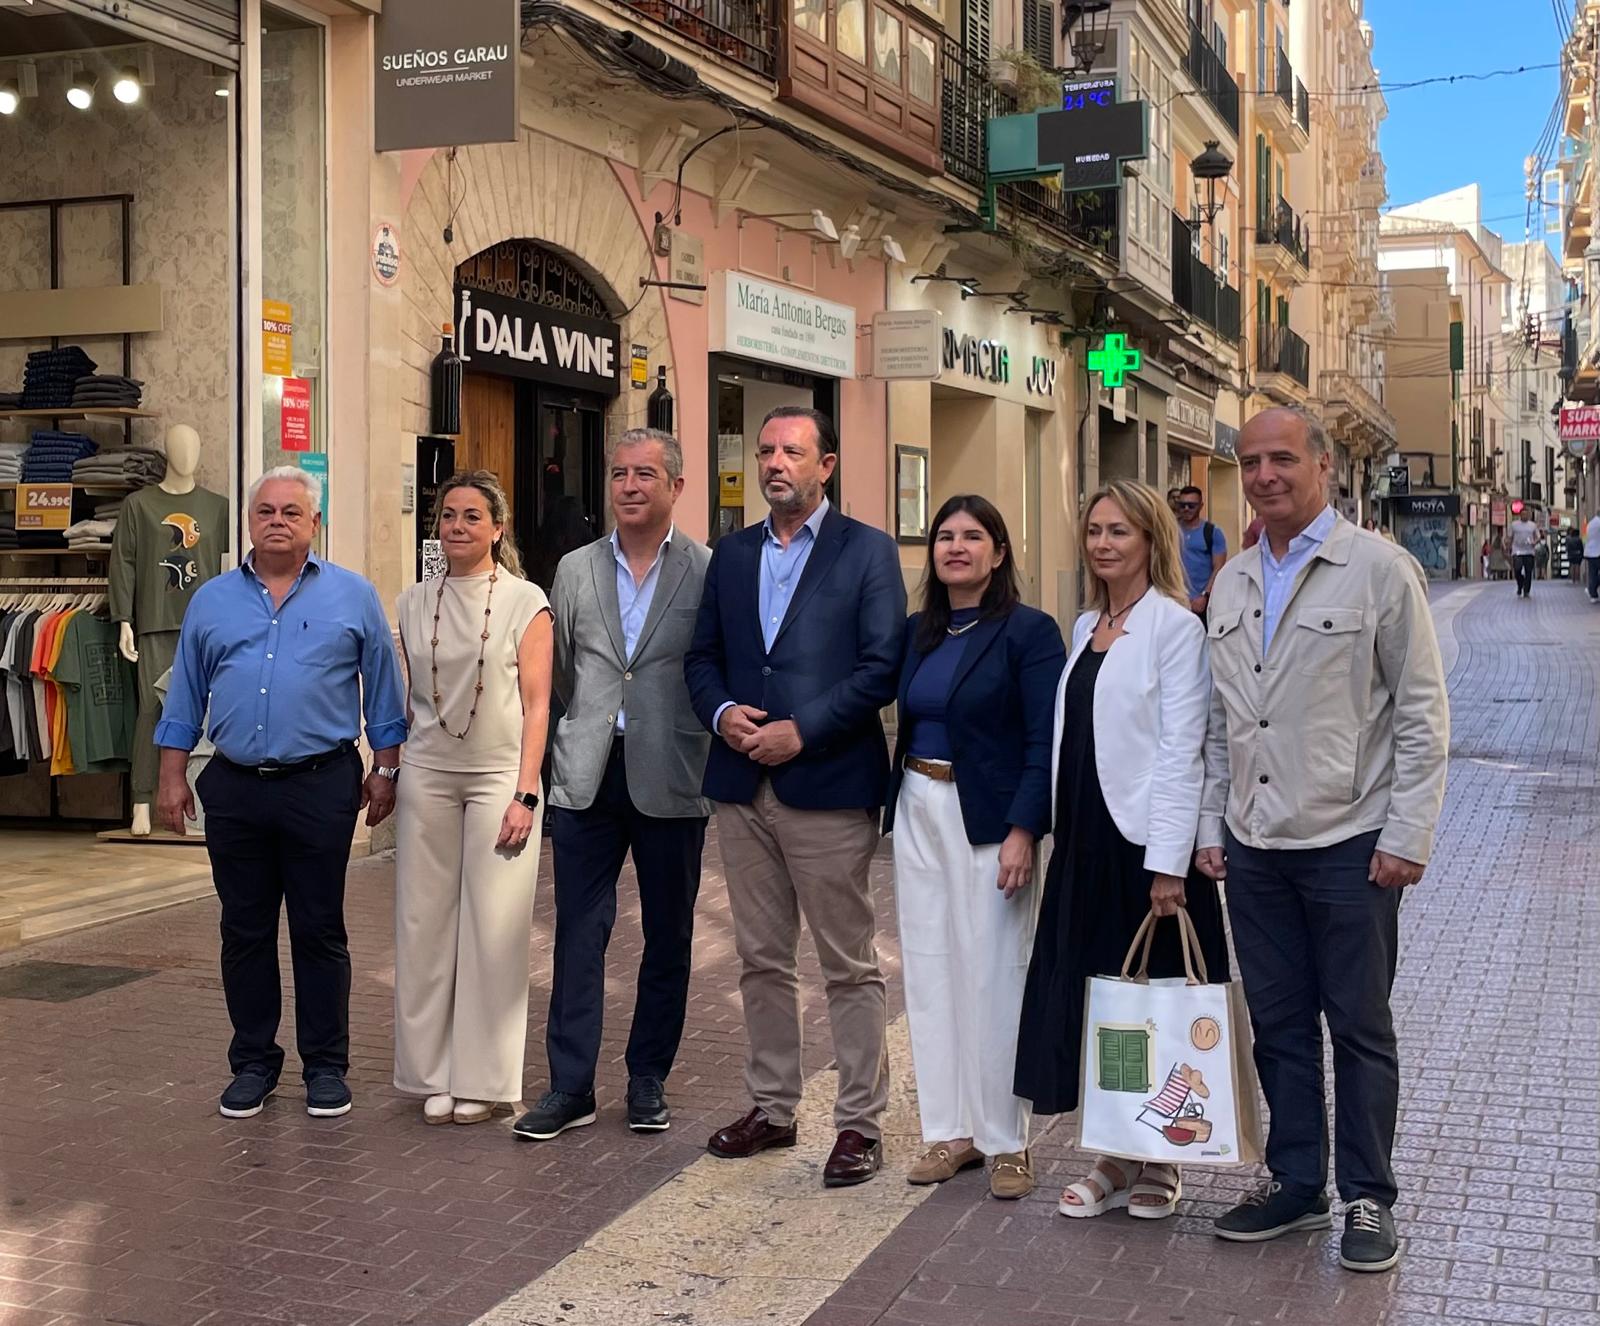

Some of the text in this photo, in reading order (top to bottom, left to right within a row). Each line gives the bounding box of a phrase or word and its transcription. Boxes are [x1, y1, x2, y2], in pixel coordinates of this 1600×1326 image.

[382, 44, 508, 71] SUEÑOS GARAU
[396, 70, 493, 87] UNDERWEAR MARKET
[1064, 80, 1114, 92] TEMPERATURA
[737, 281, 847, 340] María Antonia Bergas
[278, 323, 292, 334] OFF
[475, 308, 615, 379] DALA WINE
[942, 327, 1057, 397] RMACIA JOY
